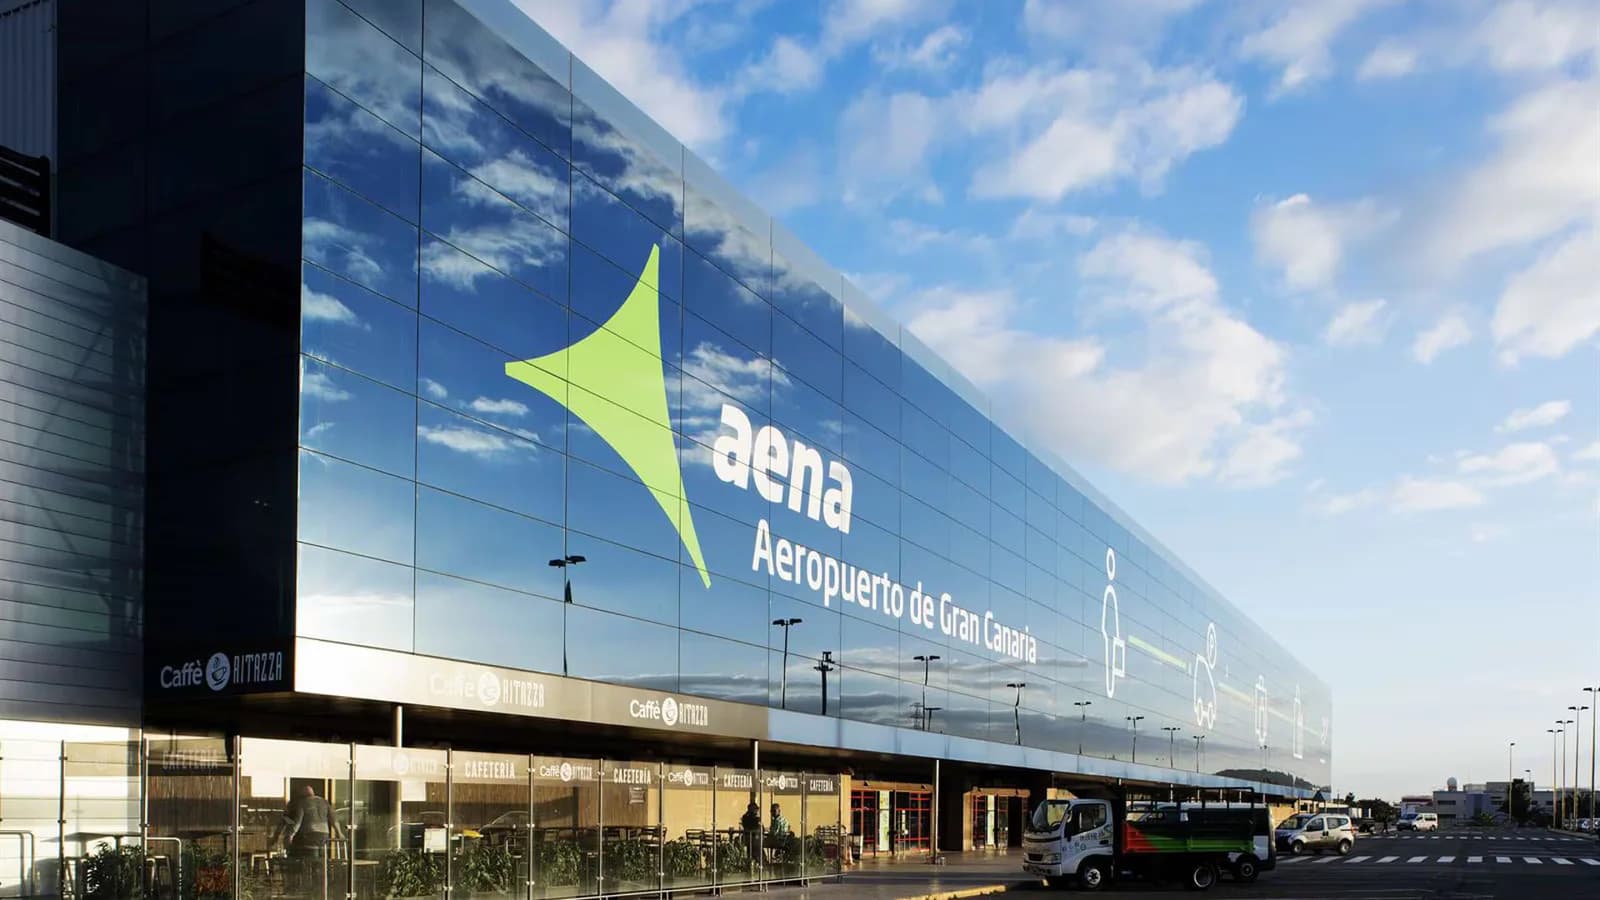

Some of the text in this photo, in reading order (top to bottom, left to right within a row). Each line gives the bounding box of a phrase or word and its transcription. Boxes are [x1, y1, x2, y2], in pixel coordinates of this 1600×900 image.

[712, 403, 853, 535] aena
[752, 518, 1037, 664] Aeropuerto de Gran Canaria
[160, 660, 203, 688] Caffè
[630, 699, 660, 719] Caffè
